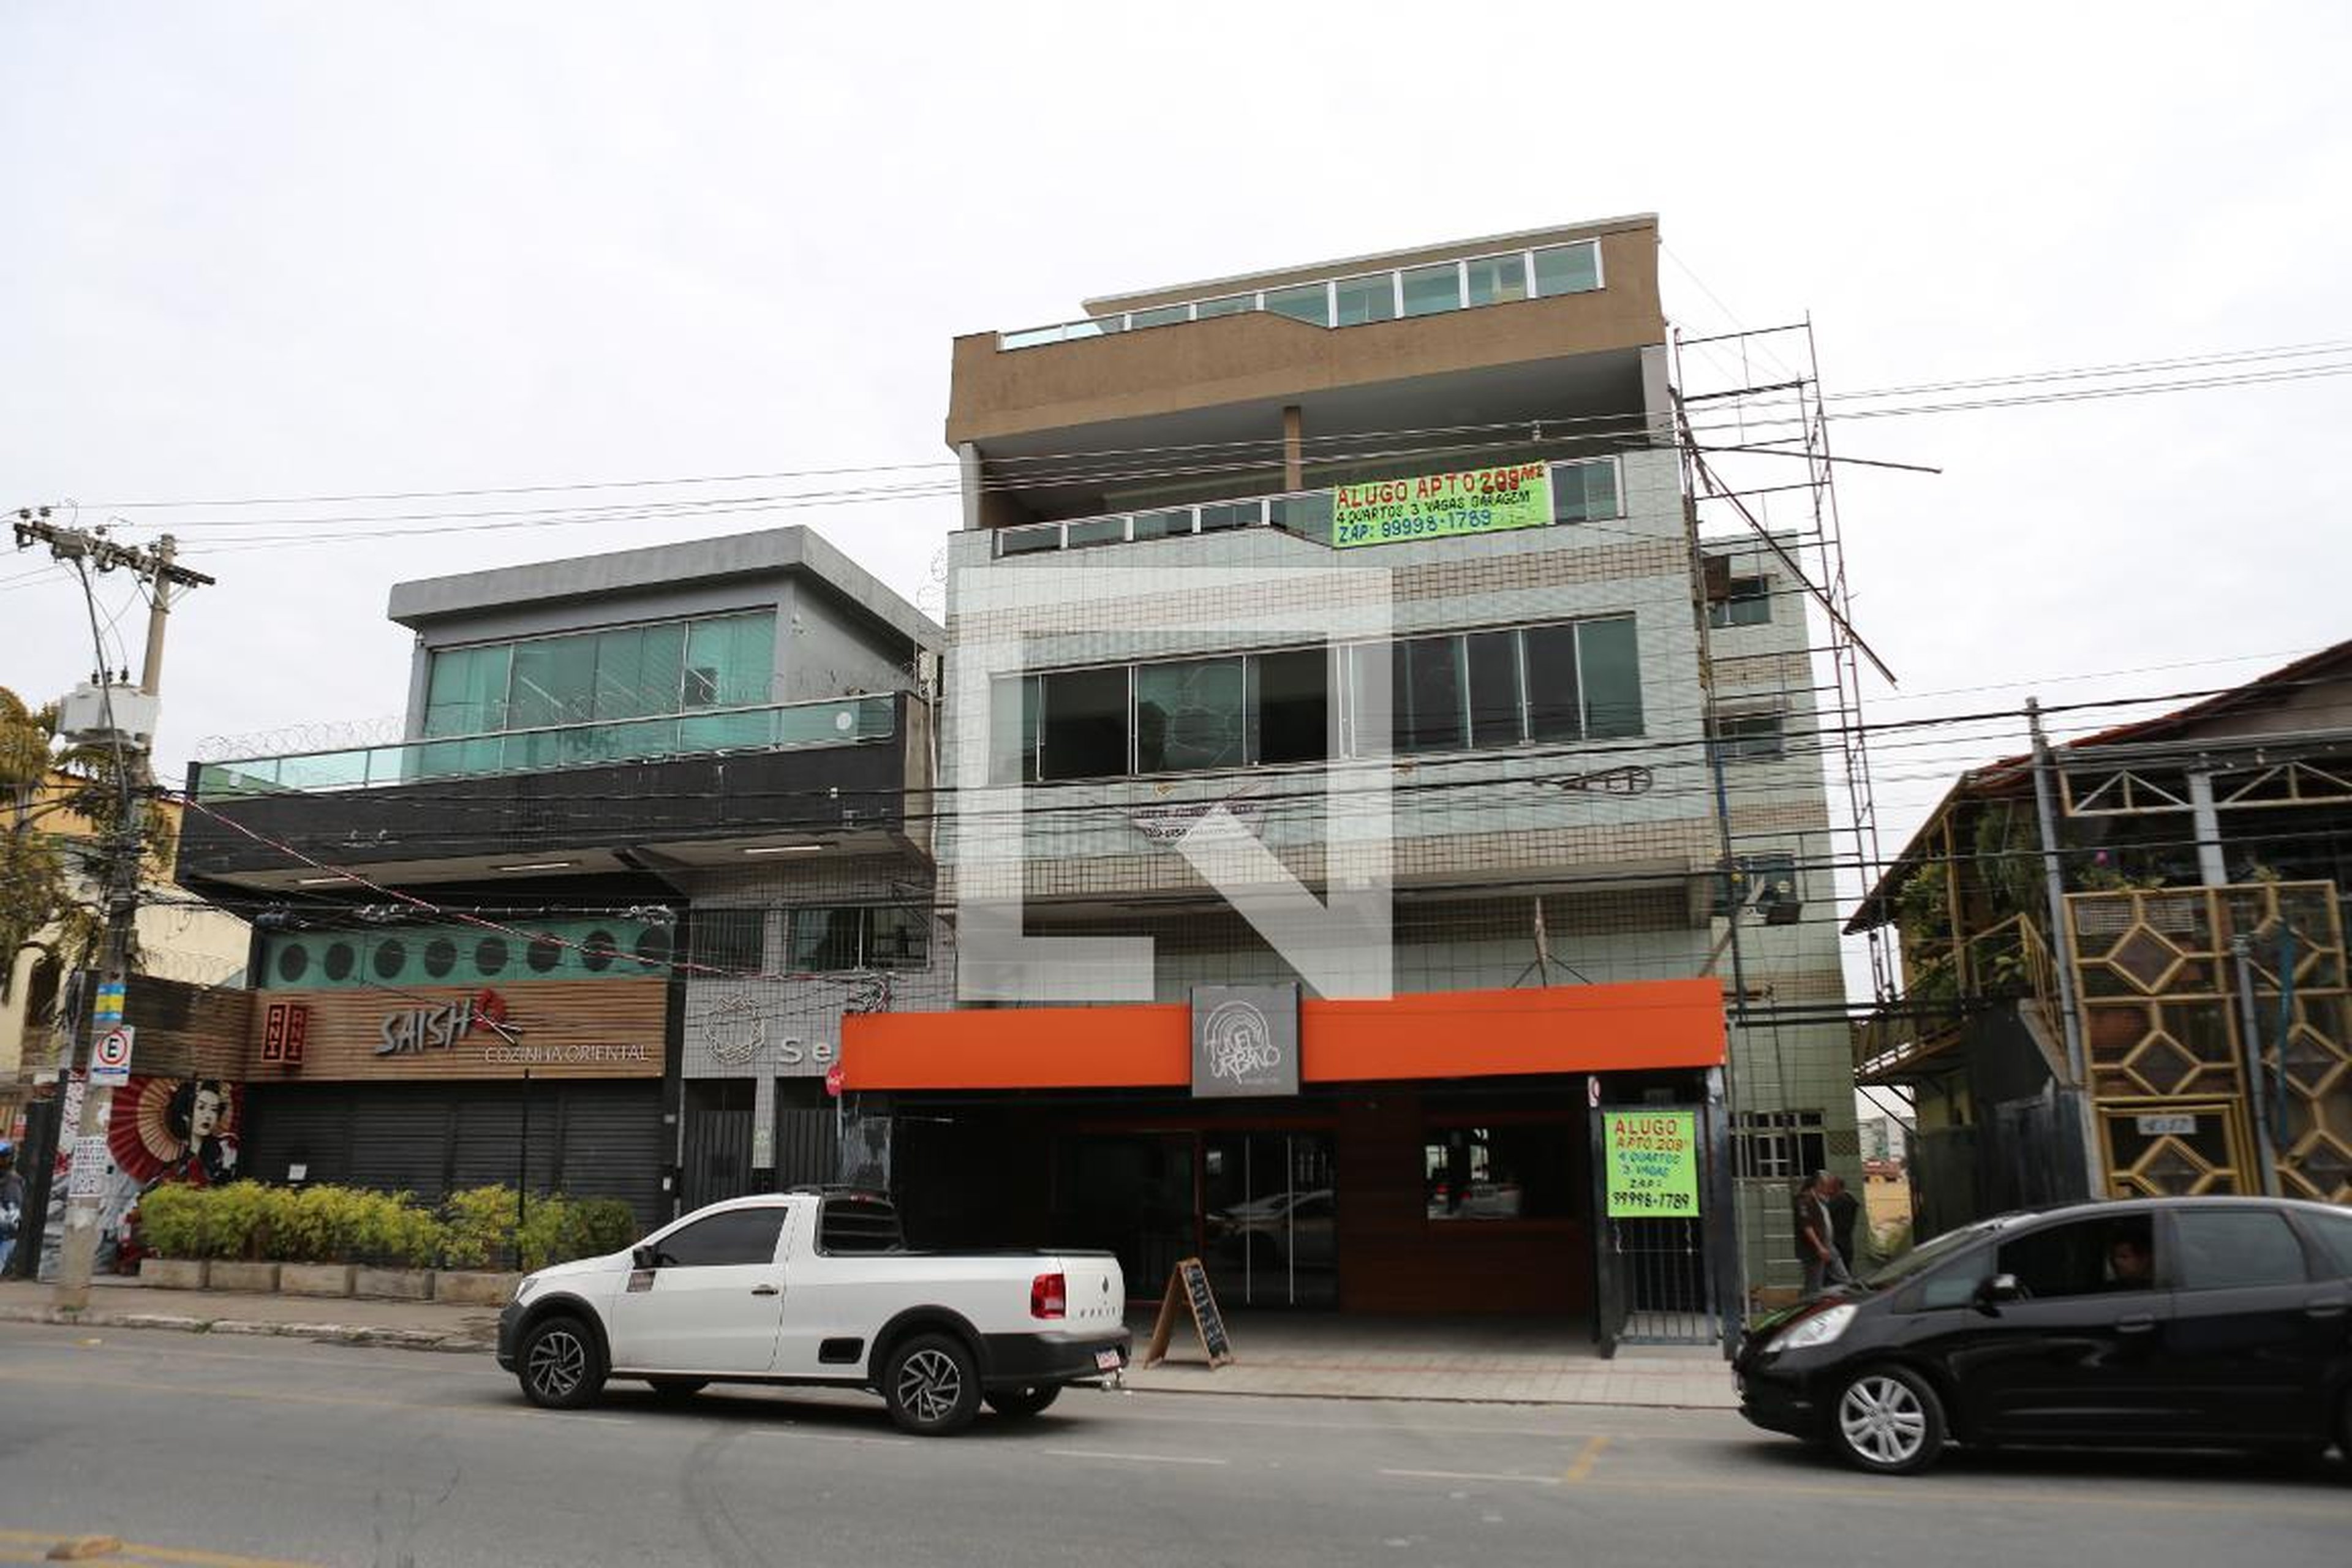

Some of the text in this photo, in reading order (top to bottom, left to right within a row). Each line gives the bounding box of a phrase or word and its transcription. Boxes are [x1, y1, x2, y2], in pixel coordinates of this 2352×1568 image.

[1336, 481, 1408, 510] ALUGO
[1416, 473, 1475, 499] APTO
[1336, 512, 1345, 524] 4
[1348, 504, 1404, 524] QUARTOS
[1410, 503, 1420, 516] 3
[1424, 497, 1466, 513] VAGAS
[107, 1037, 118, 1057] E
[565, 1044, 650, 1063] ORIENTAL
[1615, 1119, 1677, 1136] ALUGO
